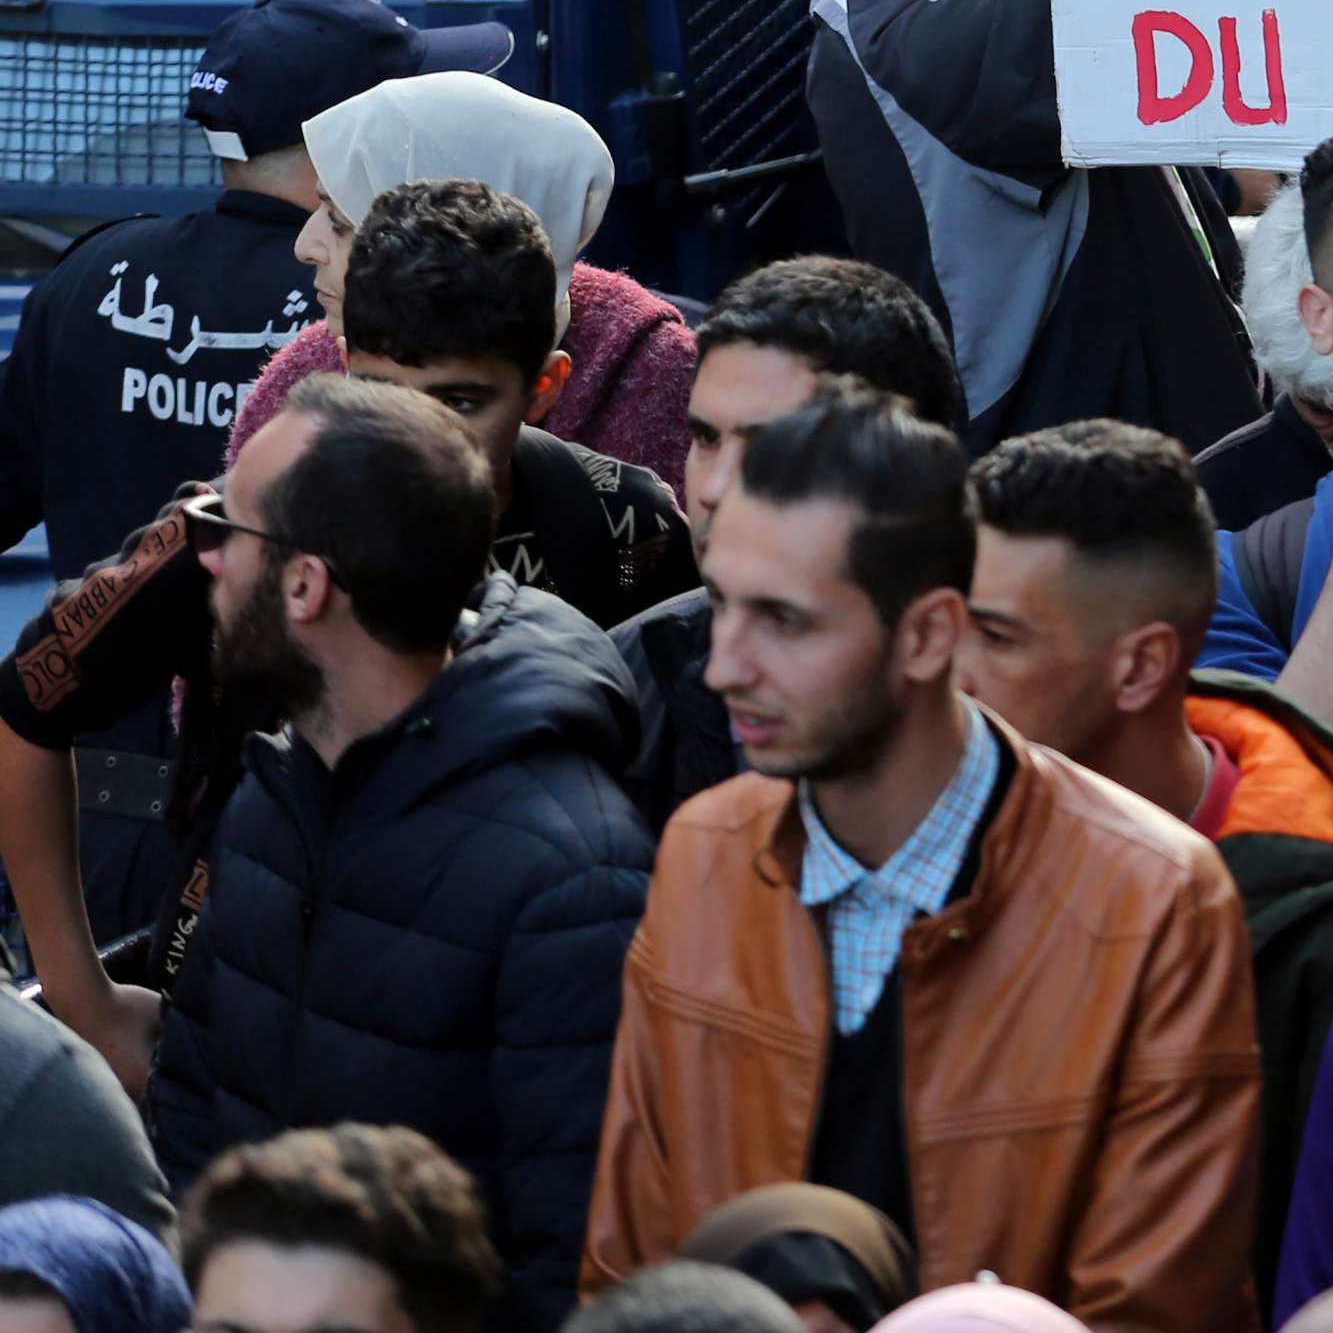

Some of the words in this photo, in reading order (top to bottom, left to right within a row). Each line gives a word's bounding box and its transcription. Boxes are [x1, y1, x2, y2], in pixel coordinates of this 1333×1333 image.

[191, 71, 229, 95] OLICE
[1132, 8, 1289, 127] DU
[97, 260, 312, 365] شرطة
